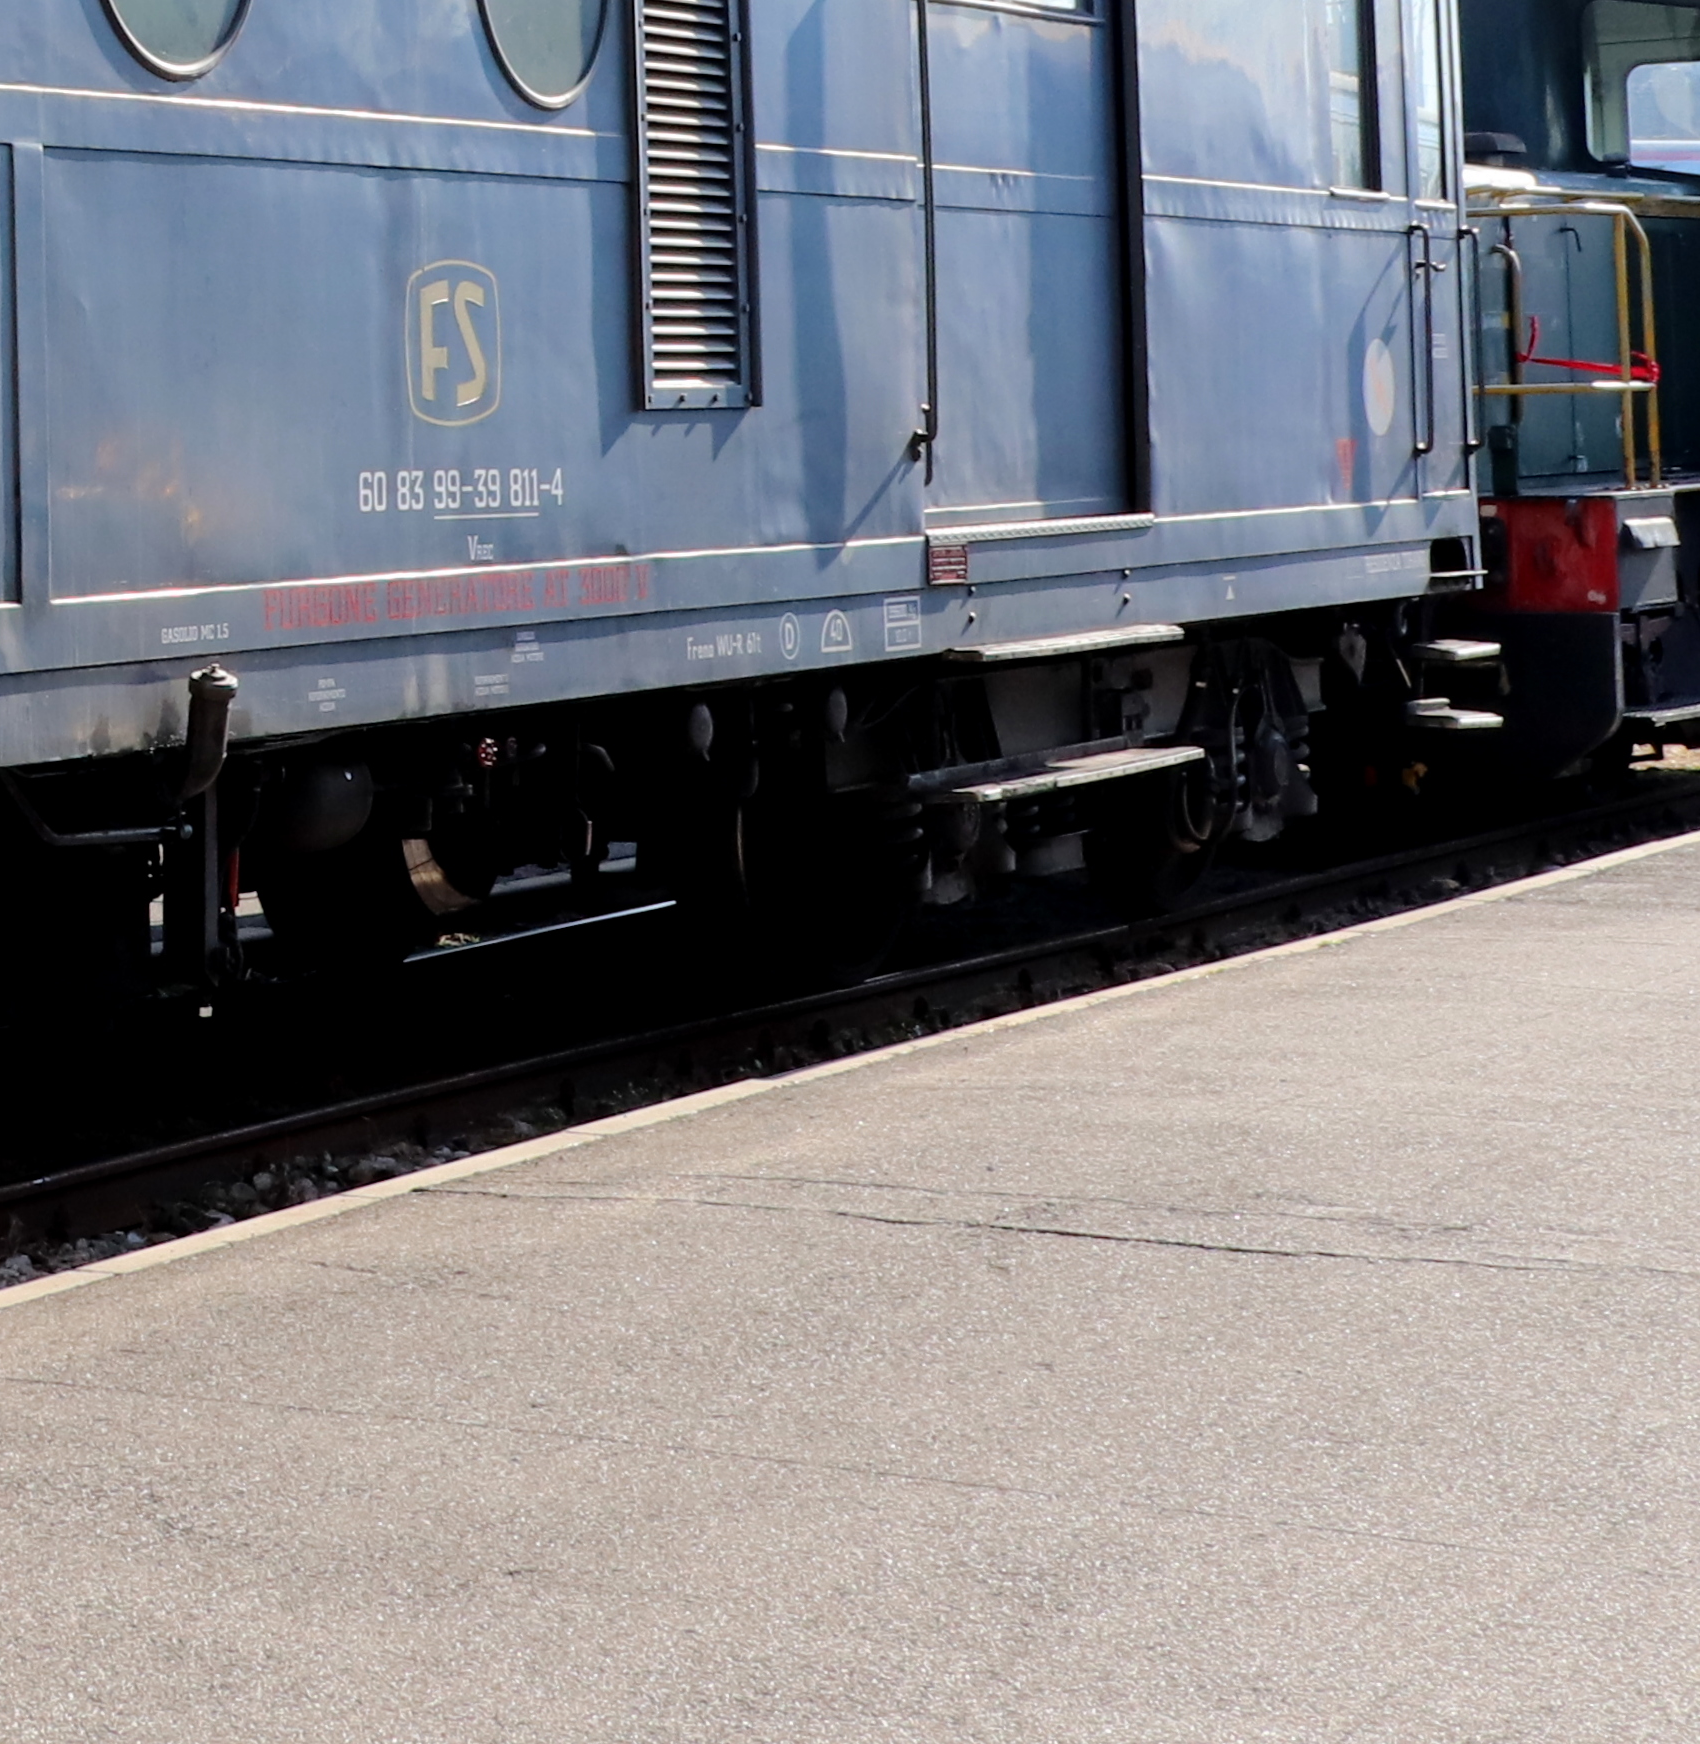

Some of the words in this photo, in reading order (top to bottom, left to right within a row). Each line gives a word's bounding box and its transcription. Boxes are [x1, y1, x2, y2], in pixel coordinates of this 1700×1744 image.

[420, 279, 489, 408] FS
[359, 471, 387, 512] 60
[397, 470, 424, 510] 83
[433, 469, 501, 509] 99-39
[510, 468, 563, 507] 811-4
[544, 568, 569, 608] AT
[578, 564, 631, 605] 3000
[635, 564, 649, 600] V
[161, 625, 198, 644] GASOLIO
[200, 624, 215, 640] MC
[785, 622, 794, 650] D
[831, 618, 842, 641] 40
[687, 636, 714, 660] Freno
[716, 633, 743, 656] WU-R
